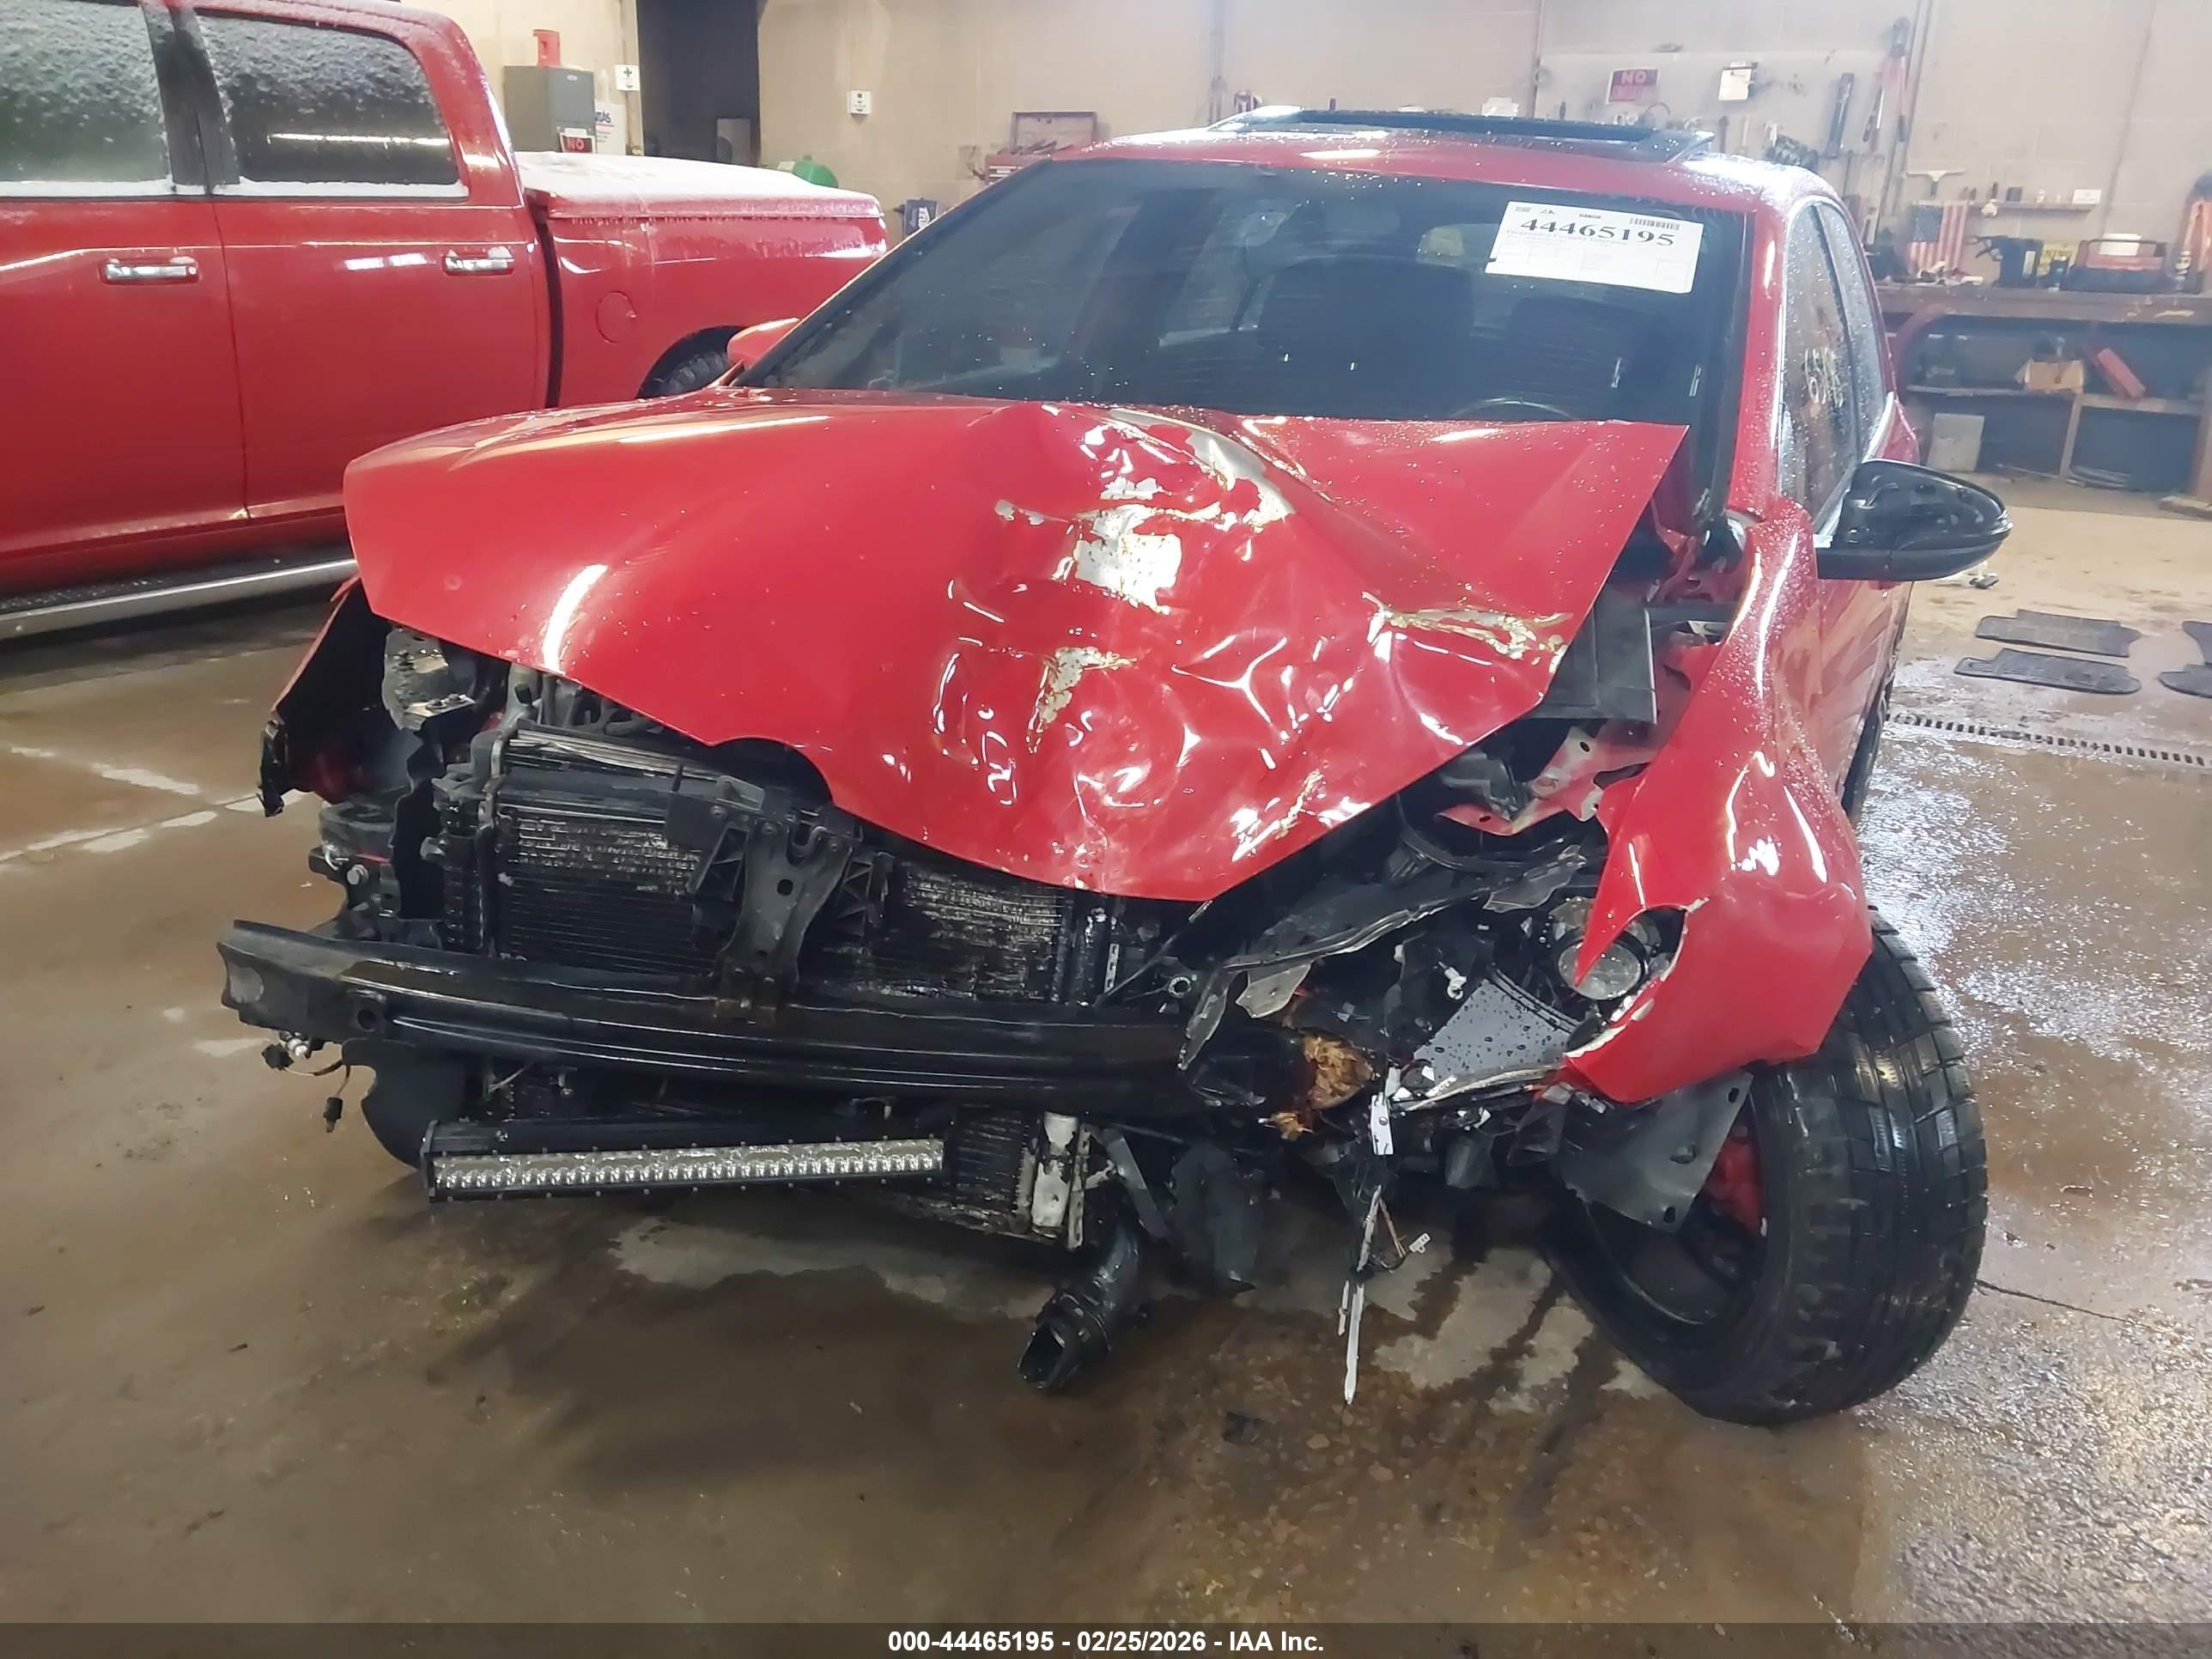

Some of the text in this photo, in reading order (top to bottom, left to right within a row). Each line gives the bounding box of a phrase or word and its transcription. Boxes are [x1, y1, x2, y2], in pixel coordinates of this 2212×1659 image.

[1620, 70, 1648, 84] NO
[567, 137, 585, 150] NO
[1521, 218, 1675, 246] 44465195
